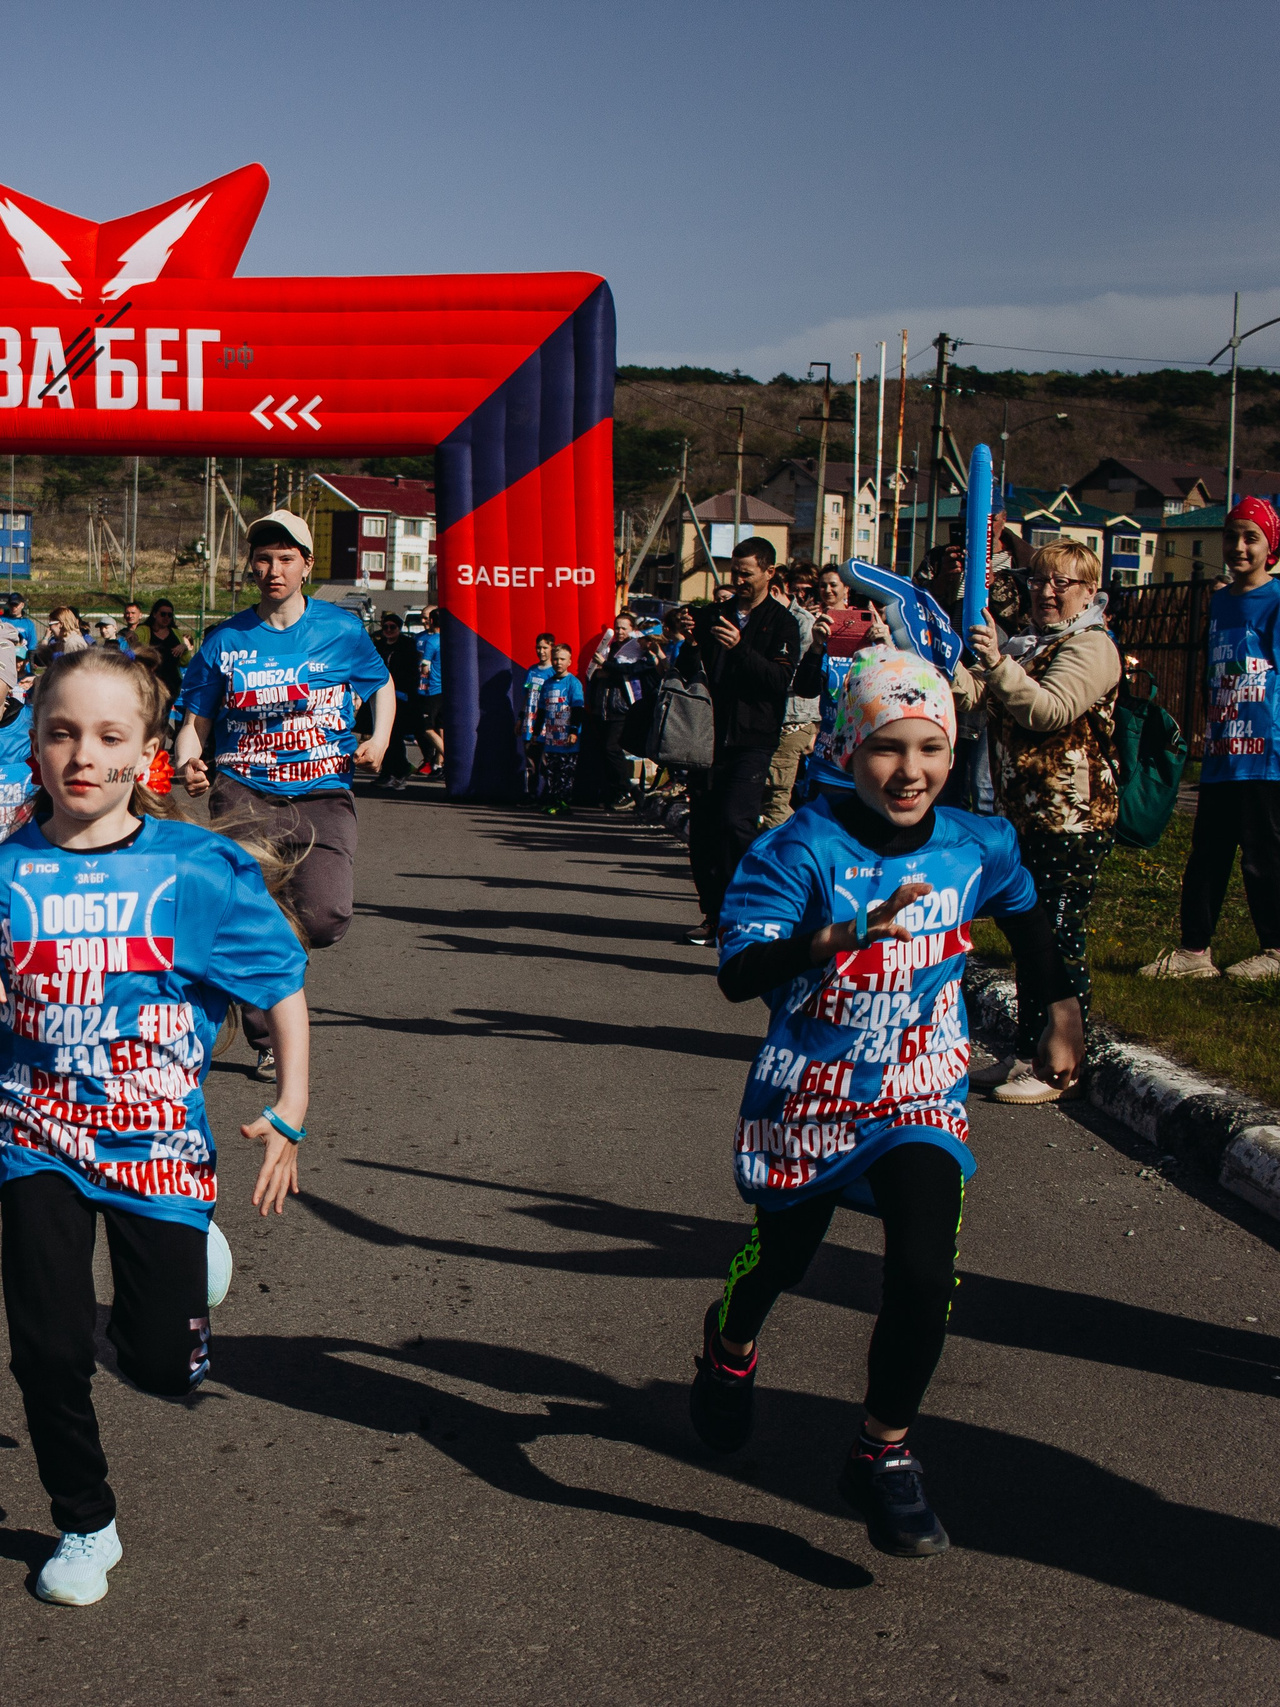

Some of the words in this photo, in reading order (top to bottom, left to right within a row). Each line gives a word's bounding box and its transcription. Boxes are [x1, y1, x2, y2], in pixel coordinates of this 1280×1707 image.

[457, 564, 596, 588] ЗАБЕГ.РФ
[247, 667, 296, 689] 00524
[255, 685, 289, 706] 500М
[35, 863, 60, 874] ПСБ
[860, 867, 883, 878] ПСБ
[42, 891, 139, 934] 00517
[56, 936, 129, 974] 500М
[883, 931, 946, 973] 500М
[755, 1045, 854, 1098] #ЗАБЕГ
